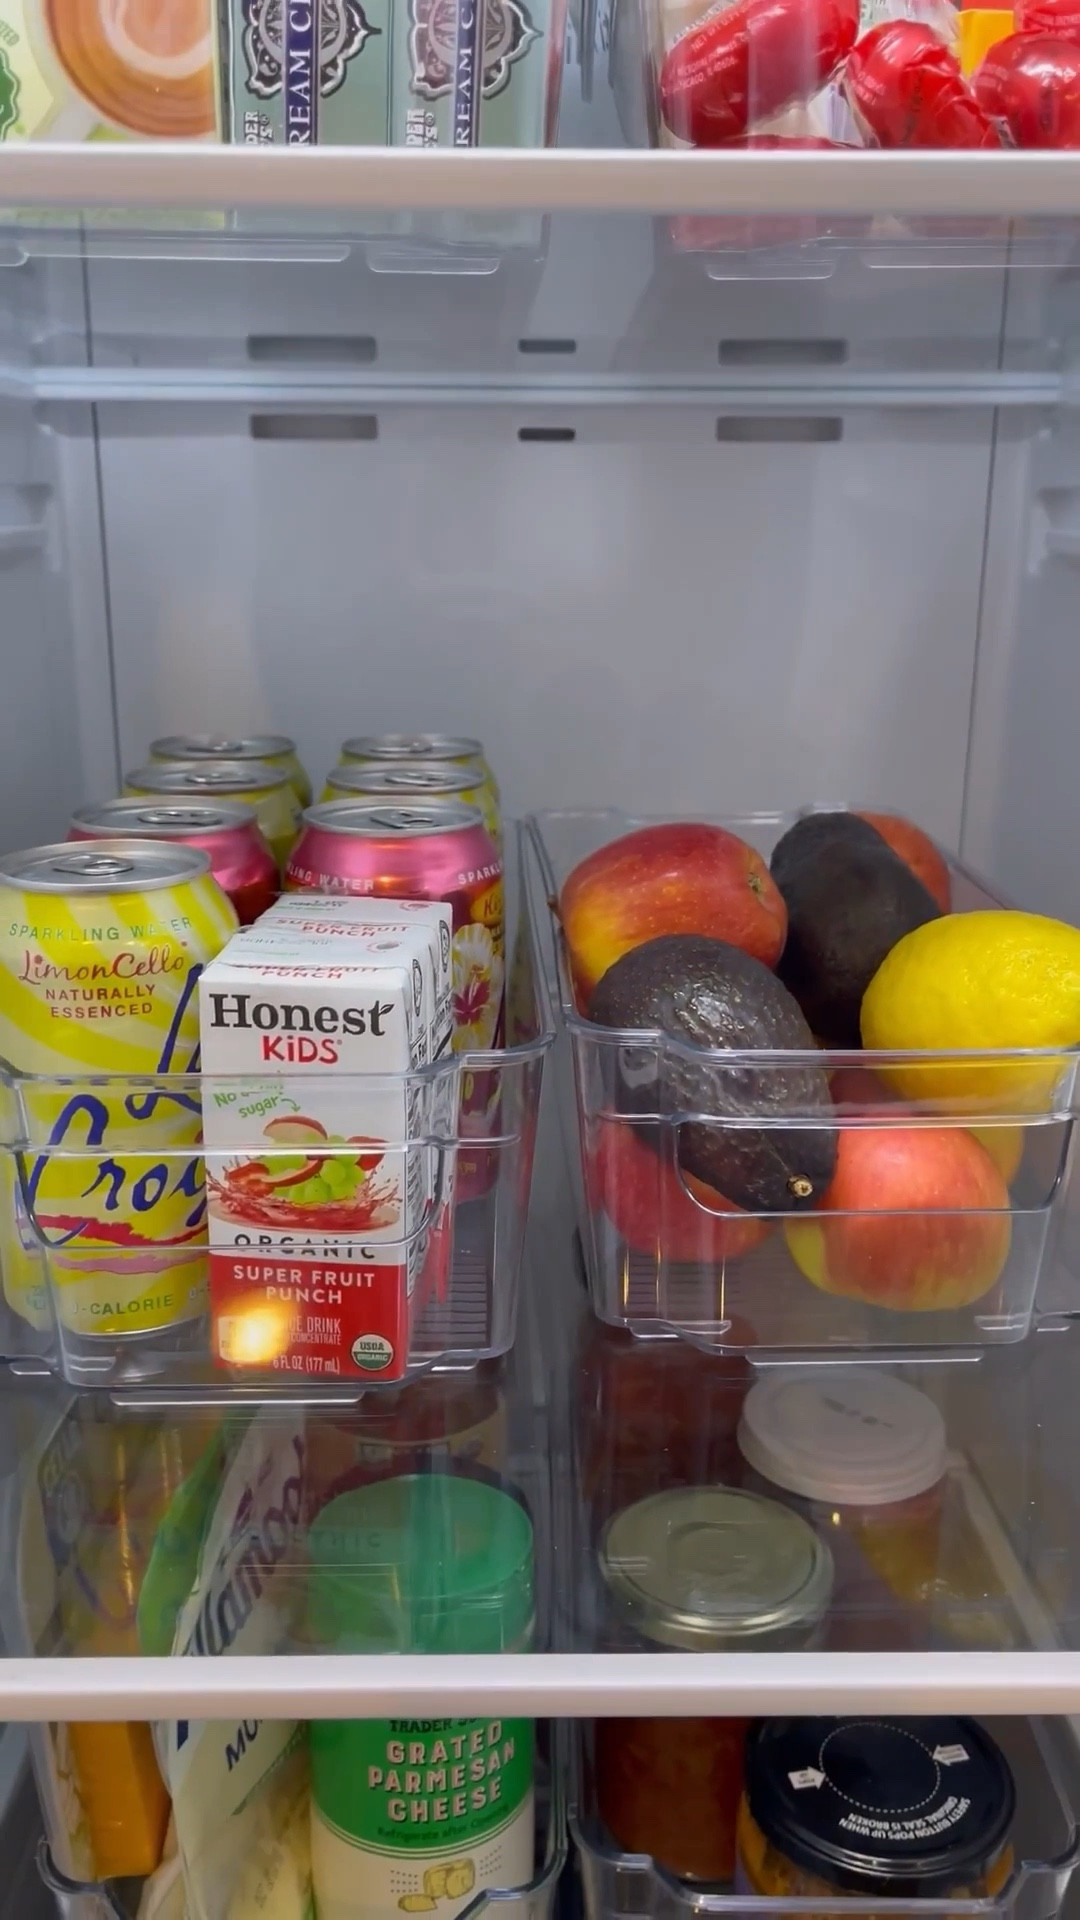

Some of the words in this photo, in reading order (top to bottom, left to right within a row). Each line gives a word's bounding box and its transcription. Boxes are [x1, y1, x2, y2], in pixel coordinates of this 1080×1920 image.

[289, 48, 311, 145] REAM
[456, 47, 472, 145] REAM
[245, 111, 258, 144] DER
[407, 109, 425, 145] DER
[320, 874, 374, 891] WATER
[10, 922, 120, 941] SPARKLING
[130, 916, 192, 938] WAER
[302, 926, 376, 937] PUNCH
[349, 924, 411, 933] FRUIT
[18, 944, 184, 985] LimonCello
[261, 971, 343, 979] PUNCH
[45, 984, 156, 1001] NATURALLY
[51, 1002, 153, 1018] ESSENCED
[209, 994, 390, 1036] Honest
[212, 1092, 237, 1107] No
[238, 1096, 279, 1117] sugar
[234, 1234, 376, 1258] ORGANIC
[233, 1265, 302, 1283] SUPER
[311, 1271, 375, 1287] FRUIT
[266, 1286, 342, 1304] PUNCH
[307, 1316, 341, 1334] DRINK
[290, 1332, 341, 1345] CONCENTRATE
[360, 1342, 385, 1351] USDA
[280, 1355, 290, 1369] FL
[292, 1356, 303, 1370] OZ
[390, 1719, 452, 1733] TRADER
[386, 1720, 502, 1765] GRATED
[368, 1737, 515, 1795] PARMESAN
[387, 1776, 502, 1822] CHEESE
[838, 1817, 870, 1836] WHEN
[847, 1812, 890, 1831] BROKEN
[891, 1821, 901, 1831] IS
[902, 1818, 927, 1831] SEAL
[915, 1818, 951, 1839] BUTTON
[871, 1829, 886, 1839] UP
[887, 1830, 914, 1840] POPS
